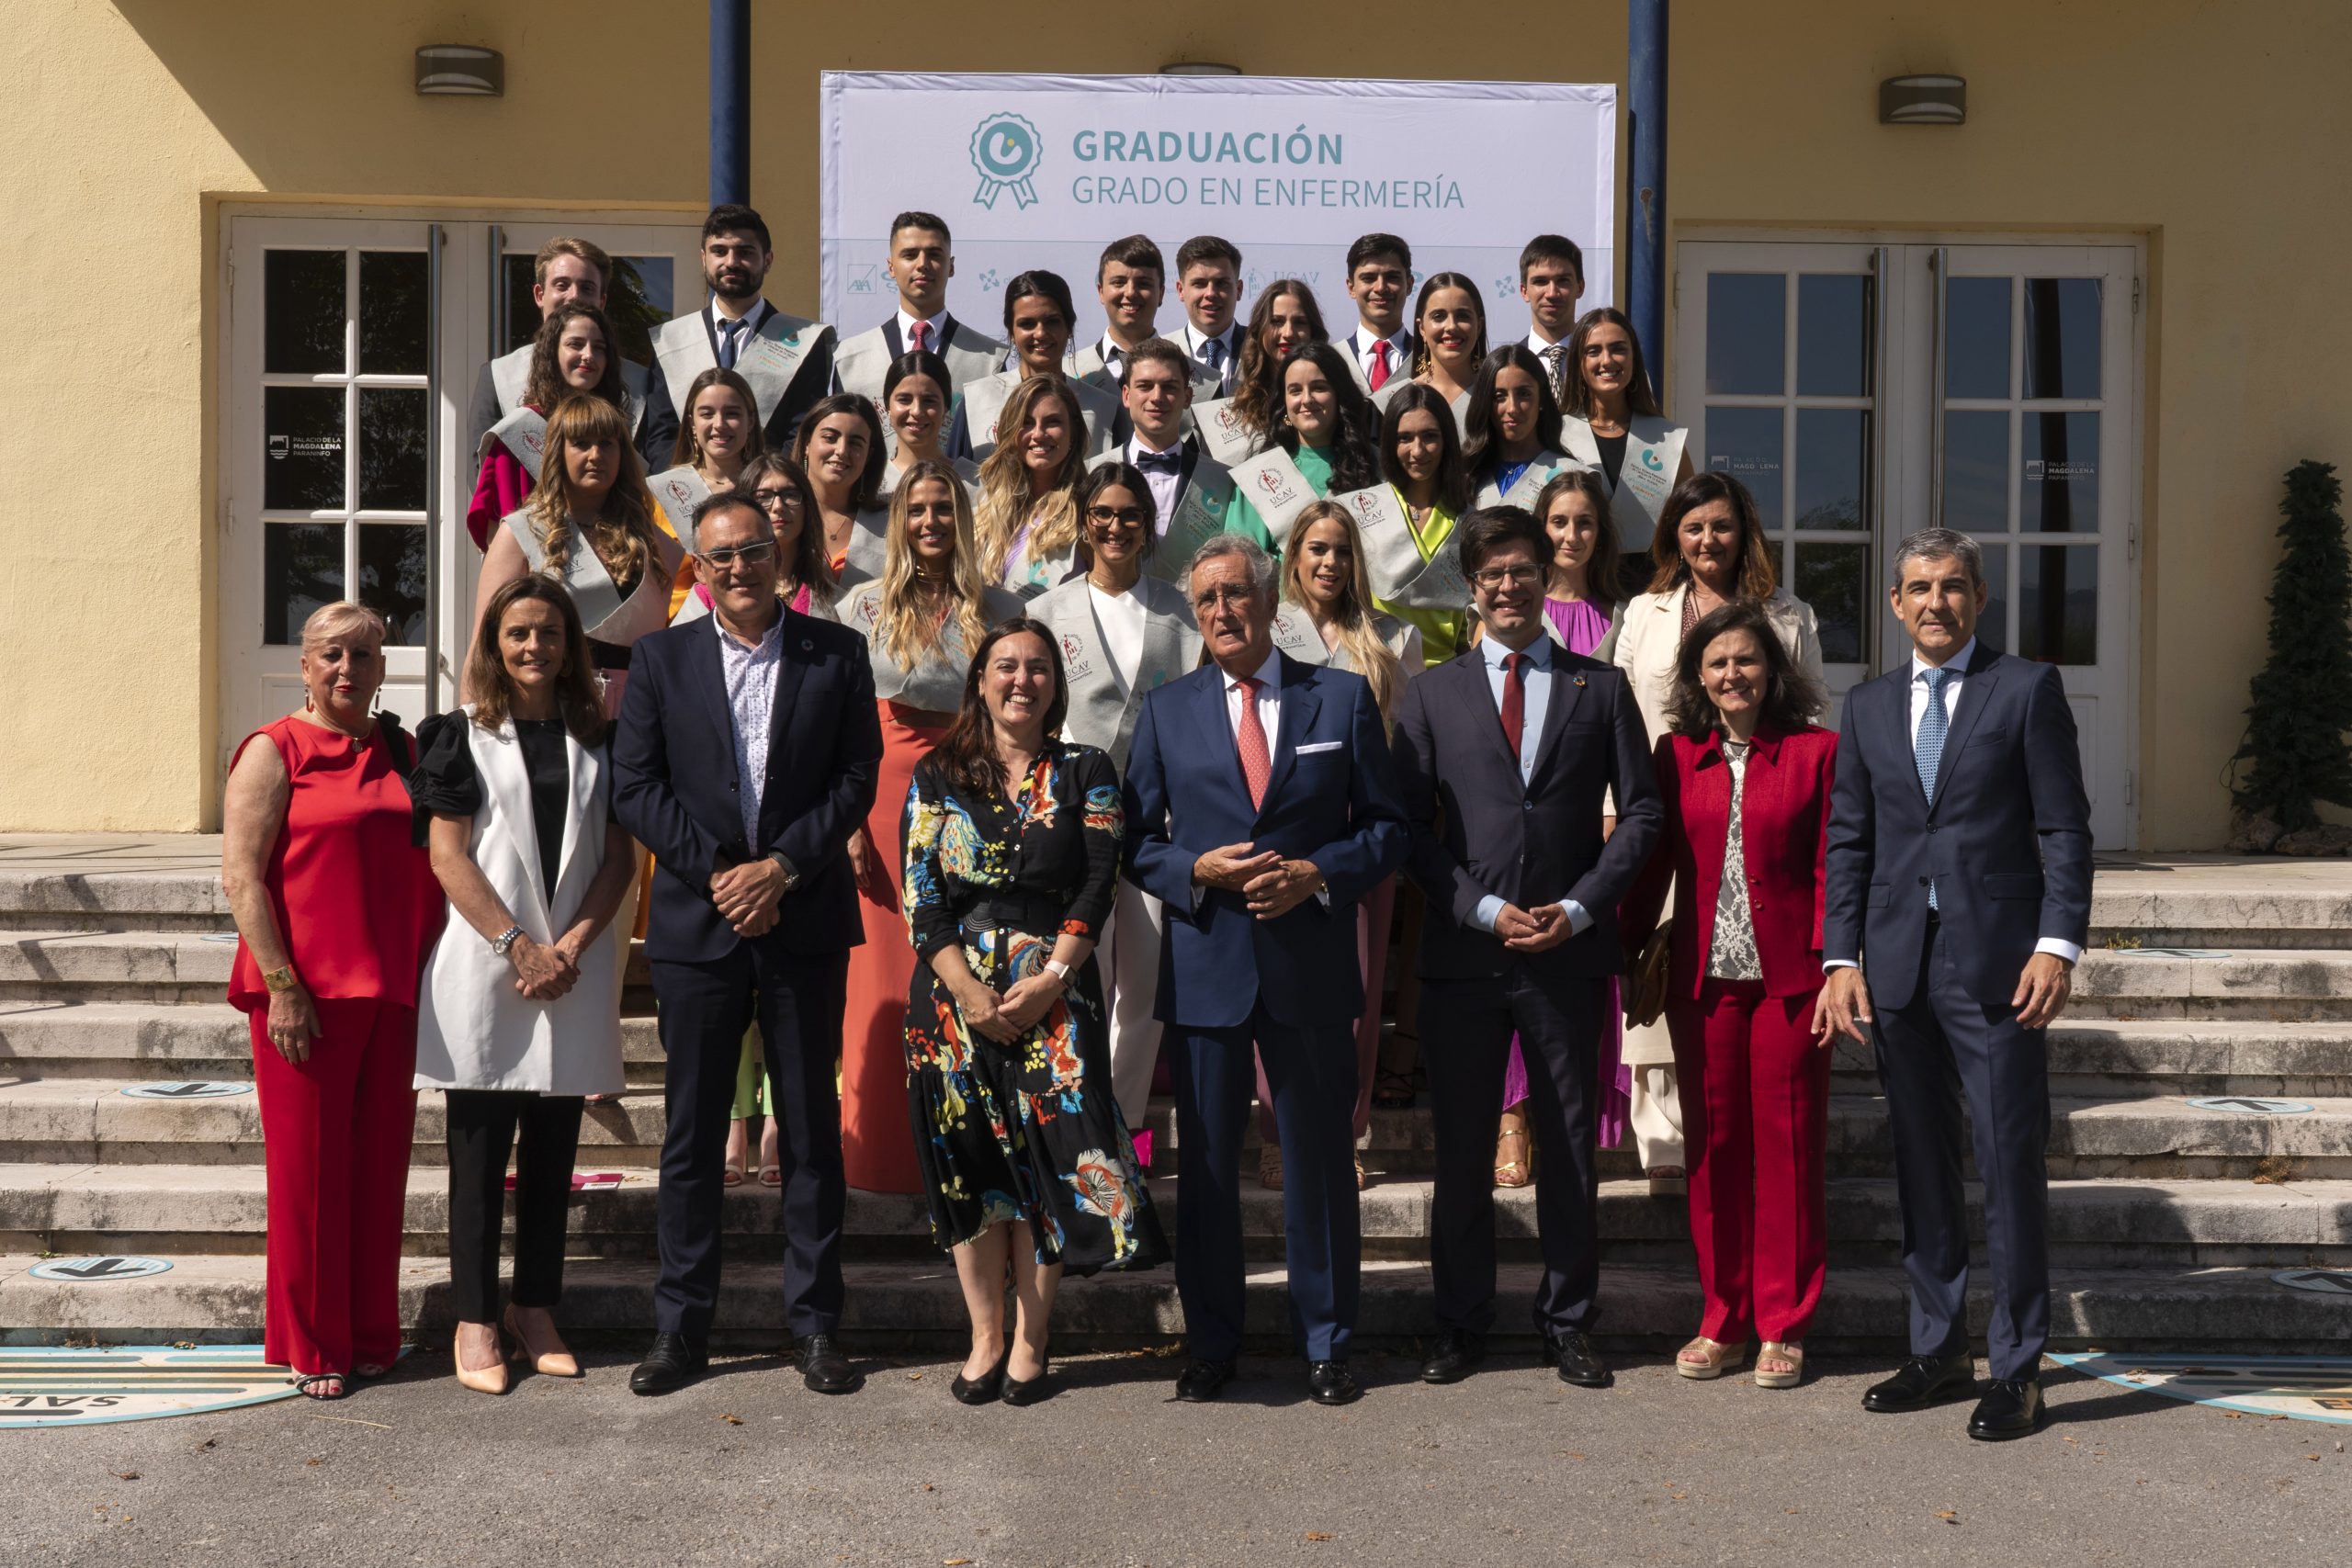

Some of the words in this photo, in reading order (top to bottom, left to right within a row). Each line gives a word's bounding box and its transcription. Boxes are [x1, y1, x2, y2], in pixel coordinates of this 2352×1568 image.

[1073, 123, 1343, 165] GRADUACIÓN
[1073, 176, 1189, 206] GRADO
[1200, 177, 1242, 206] EN
[1255, 173, 1465, 209] ENFERMERÍA
[851, 279, 871, 291] AXA
[1269, 487, 1292, 504] UCAV
[1357, 510, 1382, 525] UCAV
[1276, 635, 1302, 645] UCAV
[1065, 660, 1089, 678] UCAV
